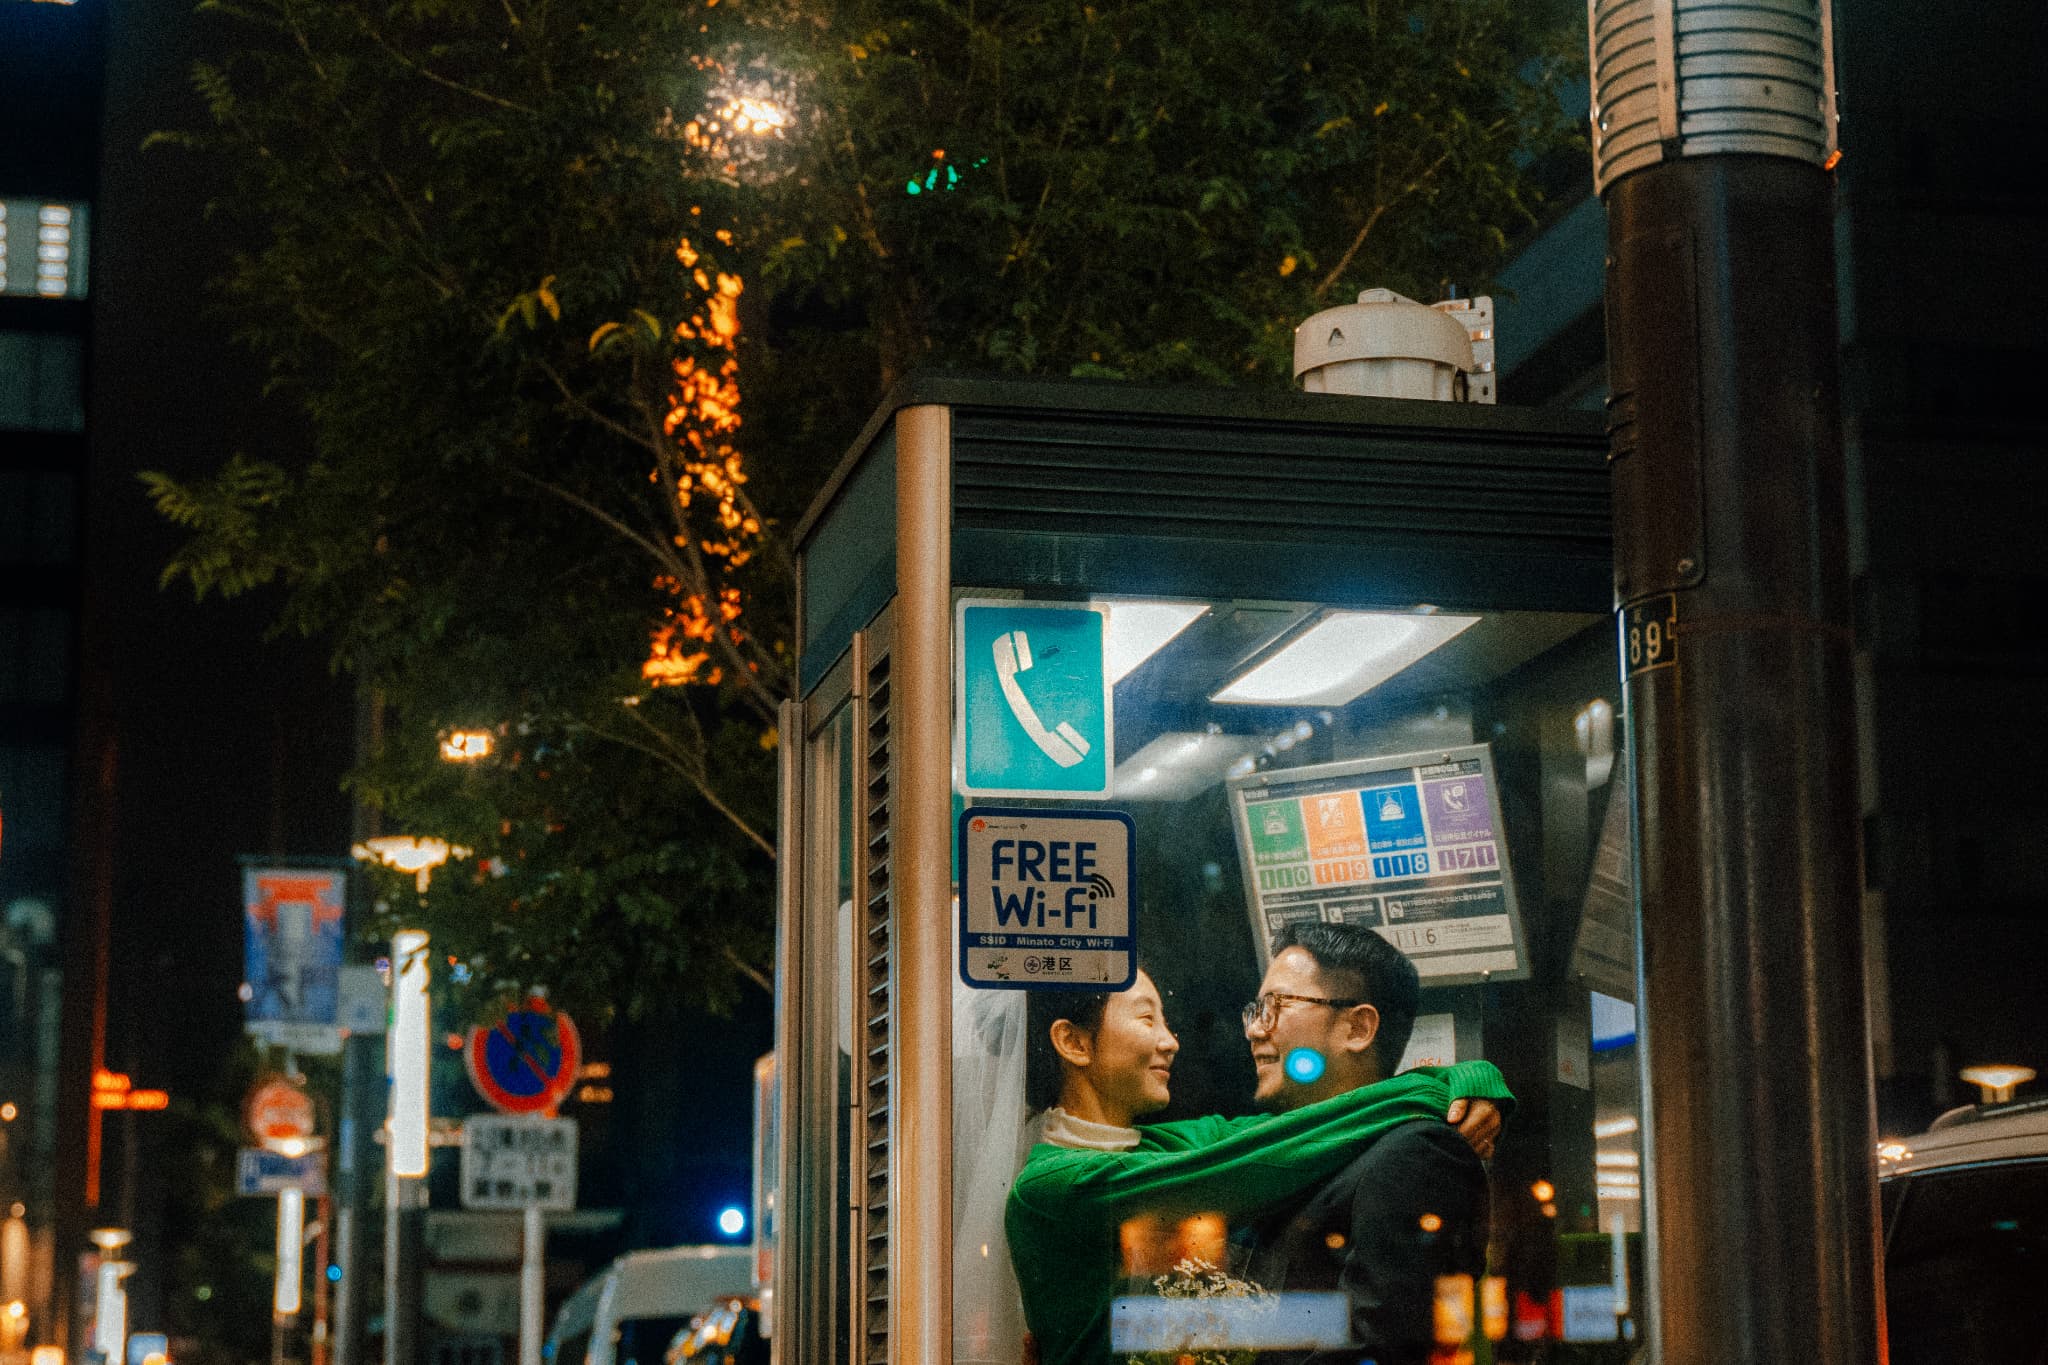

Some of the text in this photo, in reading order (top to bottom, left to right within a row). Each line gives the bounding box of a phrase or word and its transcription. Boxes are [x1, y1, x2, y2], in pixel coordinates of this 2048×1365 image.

[1631, 621, 1661, 665] 89
[992, 840, 1096, 882] FREE
[1380, 855, 1426, 876] 118
[1444, 848, 1489, 868] 171
[1265, 866, 1308, 889] 110
[1320, 861, 1366, 883] 119
[992, 886, 1097, 929] Wi-Fi
[980, 936, 1006, 945] SSID
[1016, 937, 1055, 946] Minato
[1396, 929, 1437, 948] 116
[1042, 957, 1073, 971] 港区
